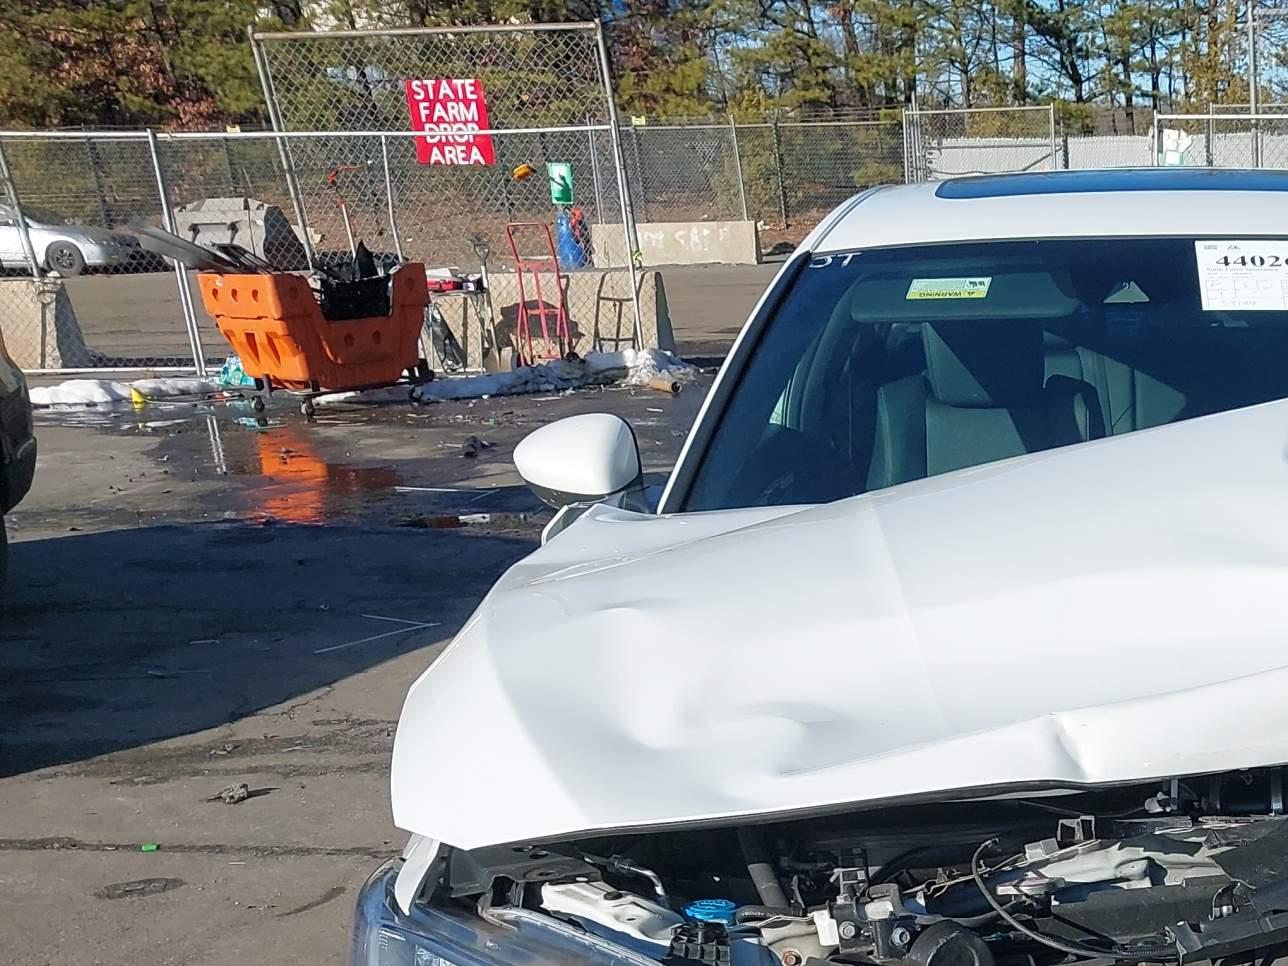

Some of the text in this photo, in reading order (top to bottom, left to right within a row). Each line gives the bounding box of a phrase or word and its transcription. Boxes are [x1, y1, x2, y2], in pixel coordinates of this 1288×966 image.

[411, 79, 478, 100] STATE
[418, 101, 479, 122] FARM
[424, 123, 480, 143] DROP
[430, 145, 486, 166] AREA
